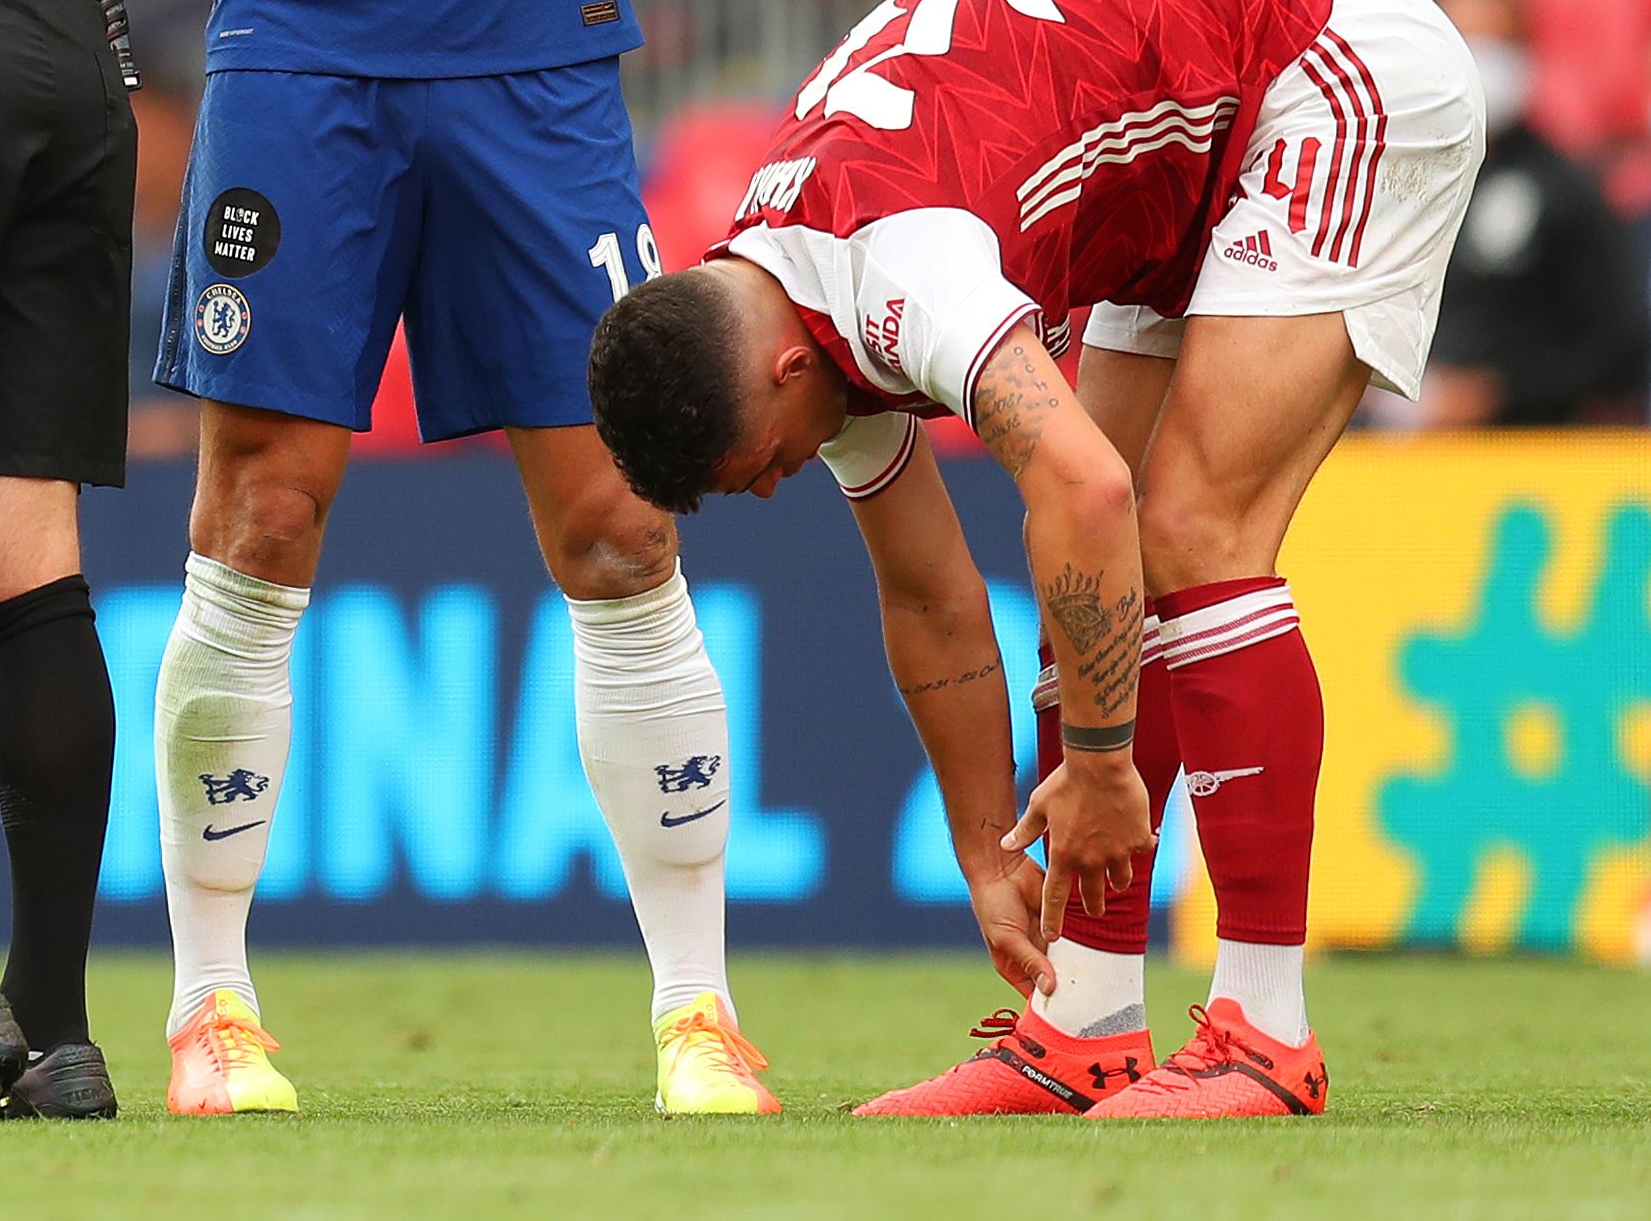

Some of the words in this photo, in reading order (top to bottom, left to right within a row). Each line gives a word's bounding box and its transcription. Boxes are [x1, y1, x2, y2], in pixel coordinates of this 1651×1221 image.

[222, 224, 254, 243] LIVES
[214, 241, 256, 262] MATTER
[1223, 246, 1279, 273] adidas
[206, 286, 242, 305] CHELSEA
